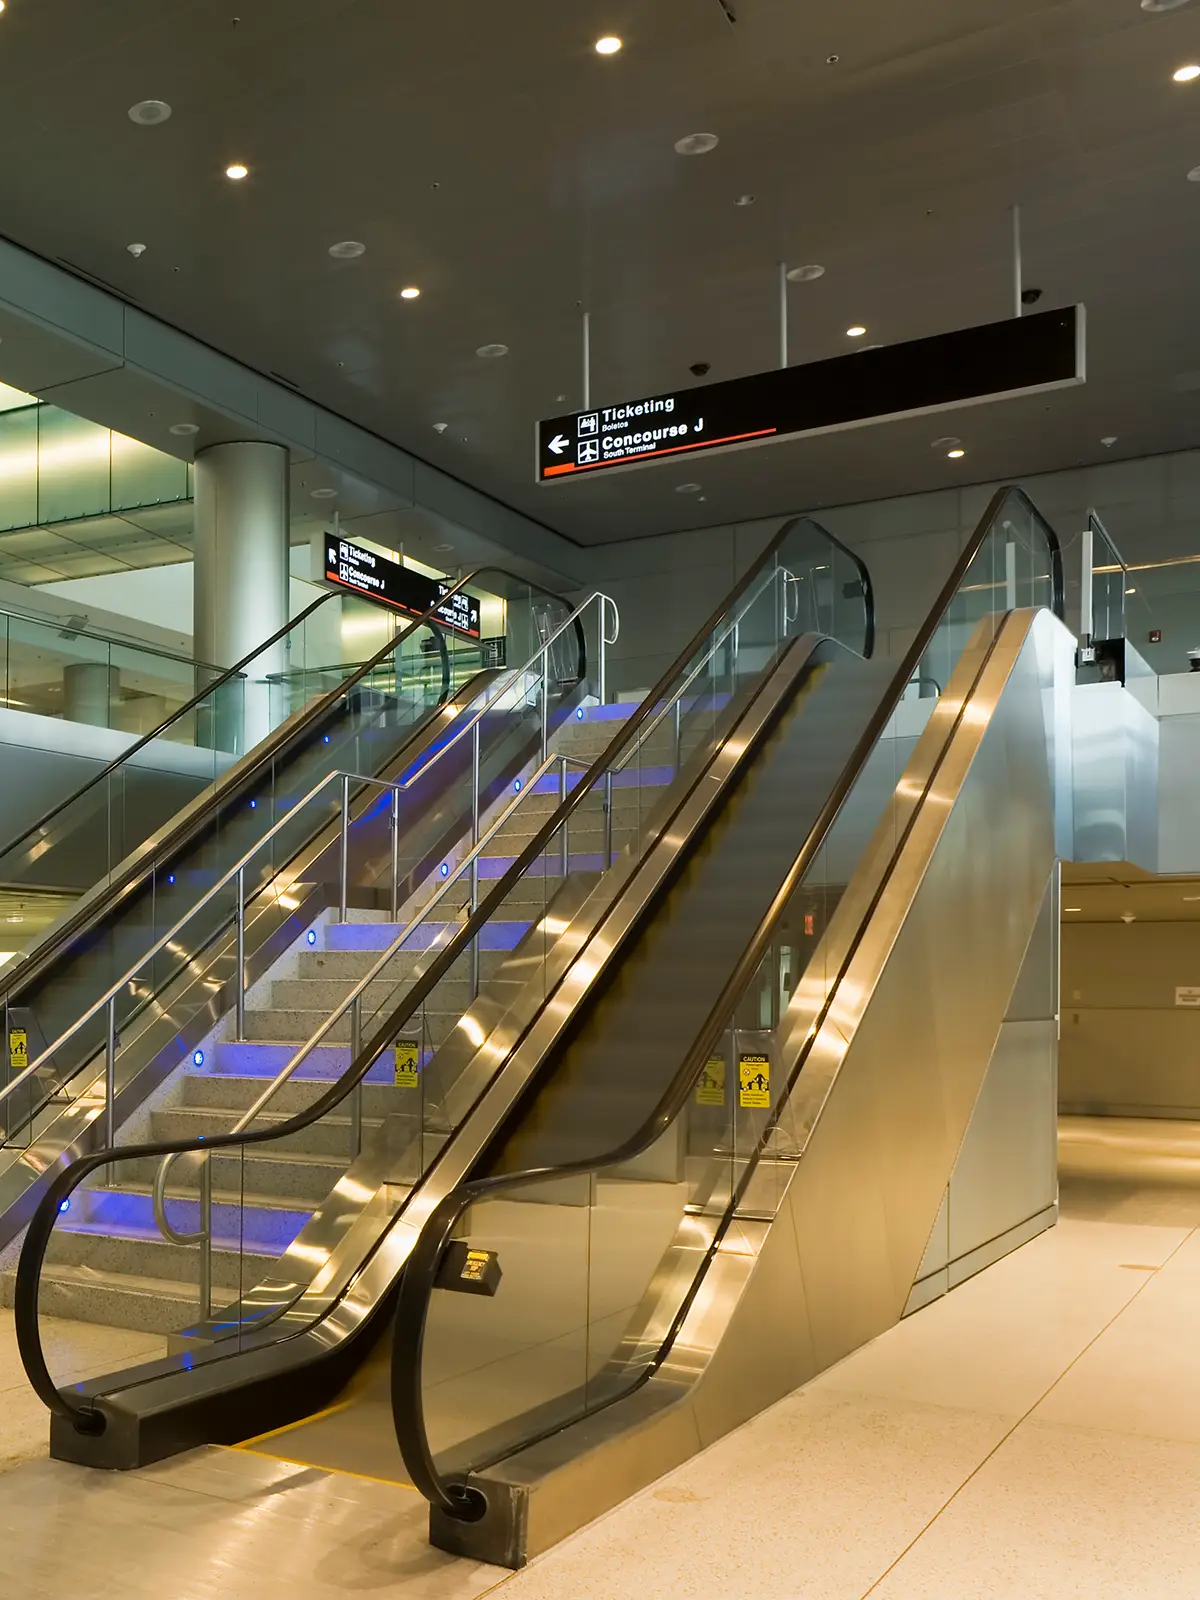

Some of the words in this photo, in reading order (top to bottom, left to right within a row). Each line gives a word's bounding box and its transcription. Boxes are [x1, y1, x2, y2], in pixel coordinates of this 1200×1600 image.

[602, 398, 675, 422] Ticketing
[602, 420, 629, 432] Boletos
[602, 423, 688, 450] Concourse
[694, 418, 704, 432] J
[603, 447, 625, 459] South
[625, 441, 656, 455] Terminal
[349, 545, 375, 567] Ticketing
[349, 566, 379, 587] Concourse
[380, 580, 385, 589] J
